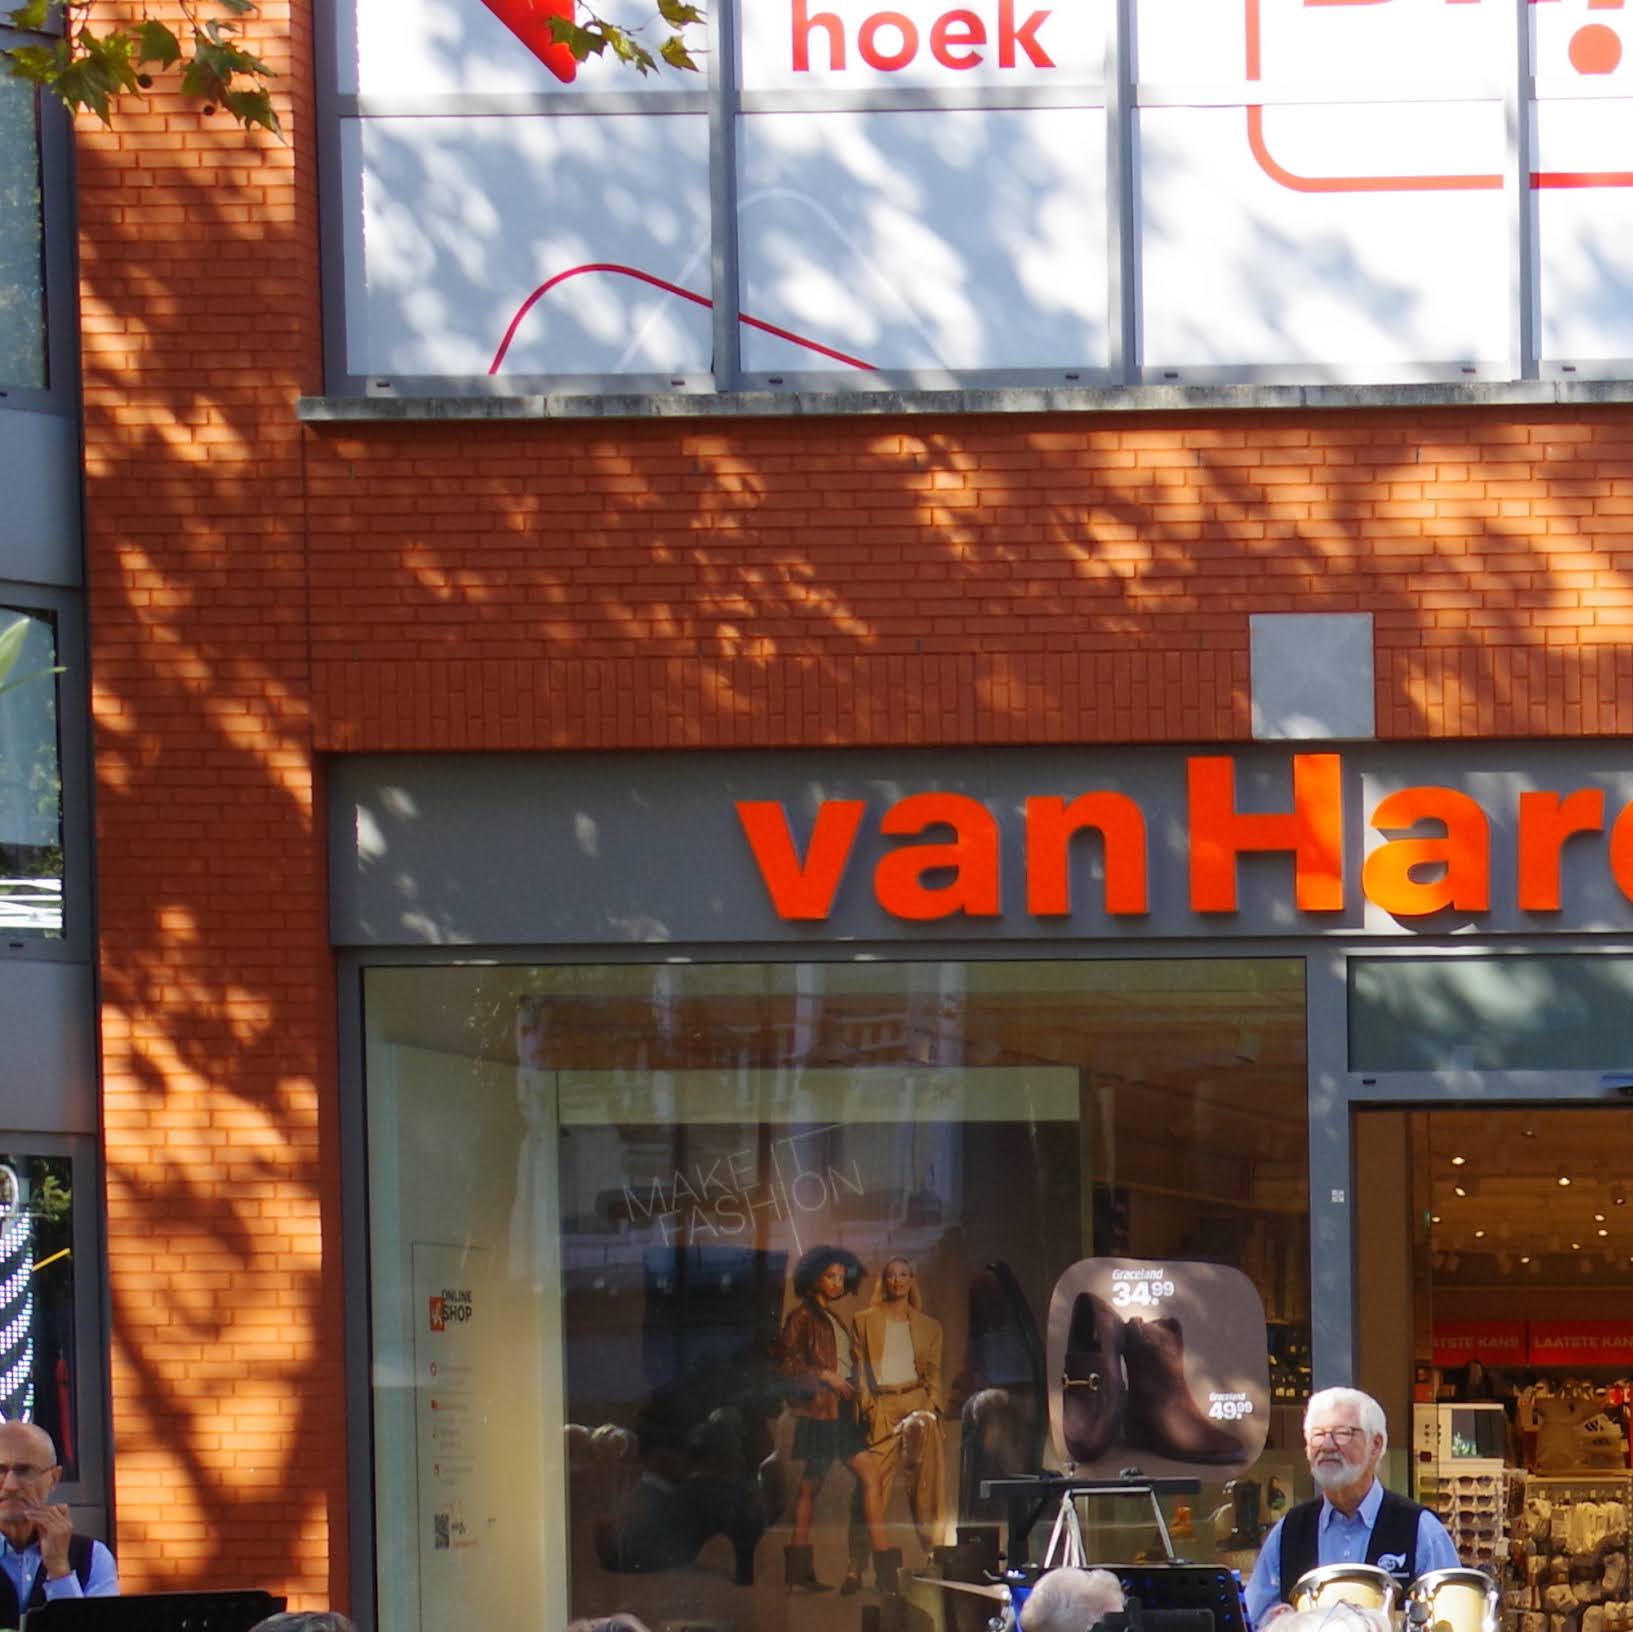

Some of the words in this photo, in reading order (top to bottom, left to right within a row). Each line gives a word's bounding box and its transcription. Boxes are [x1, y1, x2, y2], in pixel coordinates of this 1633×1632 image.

[792, 0, 1056, 72] hoek
[622, 1149, 760, 1224] MAKE
[1112, 1268, 1164, 1281] Graceland
[442, 1304, 473, 1323] SHOP
[1477, 1336, 1520, 1349] KANS
[1535, 1336, 1600, 1349] LAATSTE
